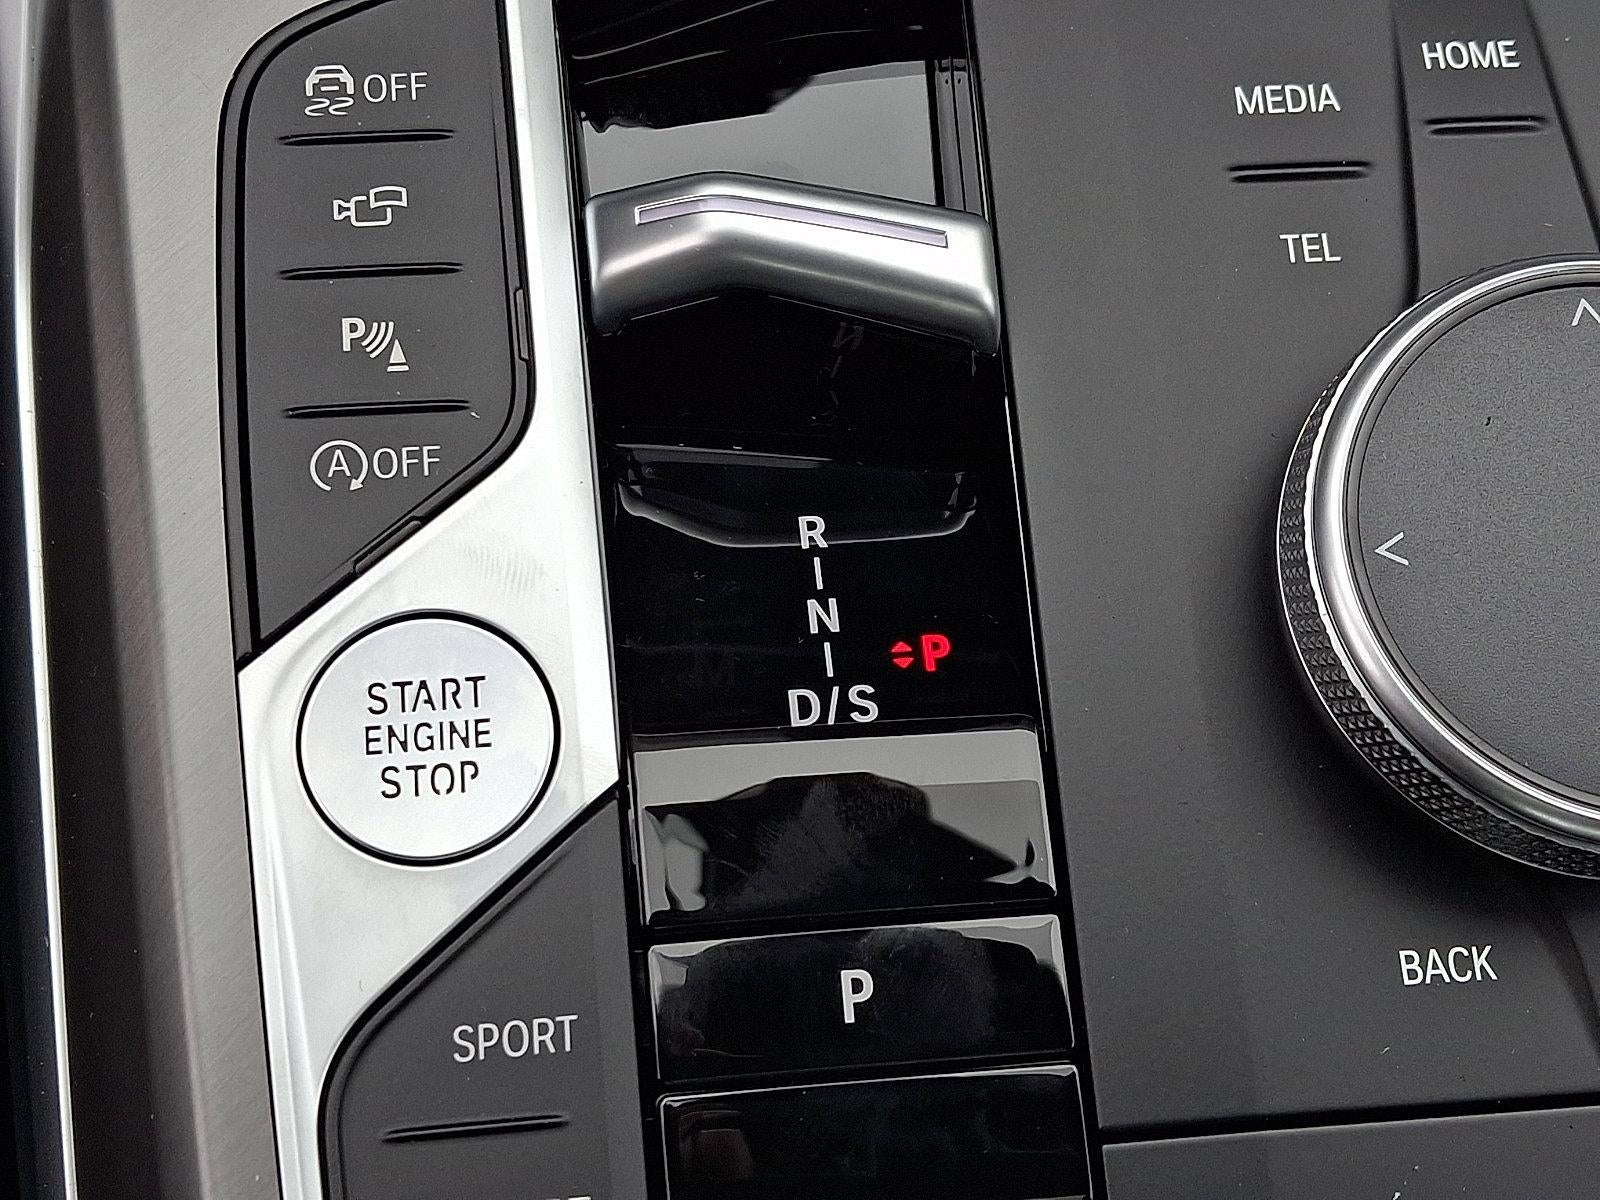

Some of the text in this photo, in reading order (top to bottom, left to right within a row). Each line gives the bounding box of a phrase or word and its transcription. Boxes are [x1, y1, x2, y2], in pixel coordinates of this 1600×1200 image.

[1421, 40, 1522, 70] HOME
[362, 72, 428, 102] OFF
[1235, 84, 1341, 114] MEDIA
[1280, 233, 1342, 264] TEL
[373, 446, 441, 478] OFF
[798, 516, 828, 549] R
[807, 598, 840, 634] N
[921, 634, 951, 672] P
[367, 676, 486, 715] START
[365, 718, 492, 755] ENGINE
[381, 761, 479, 799] STOP
[1399, 945, 1498, 985] BACK
[841, 969, 874, 1024] P
[453, 1015, 578, 1063] SPORT
